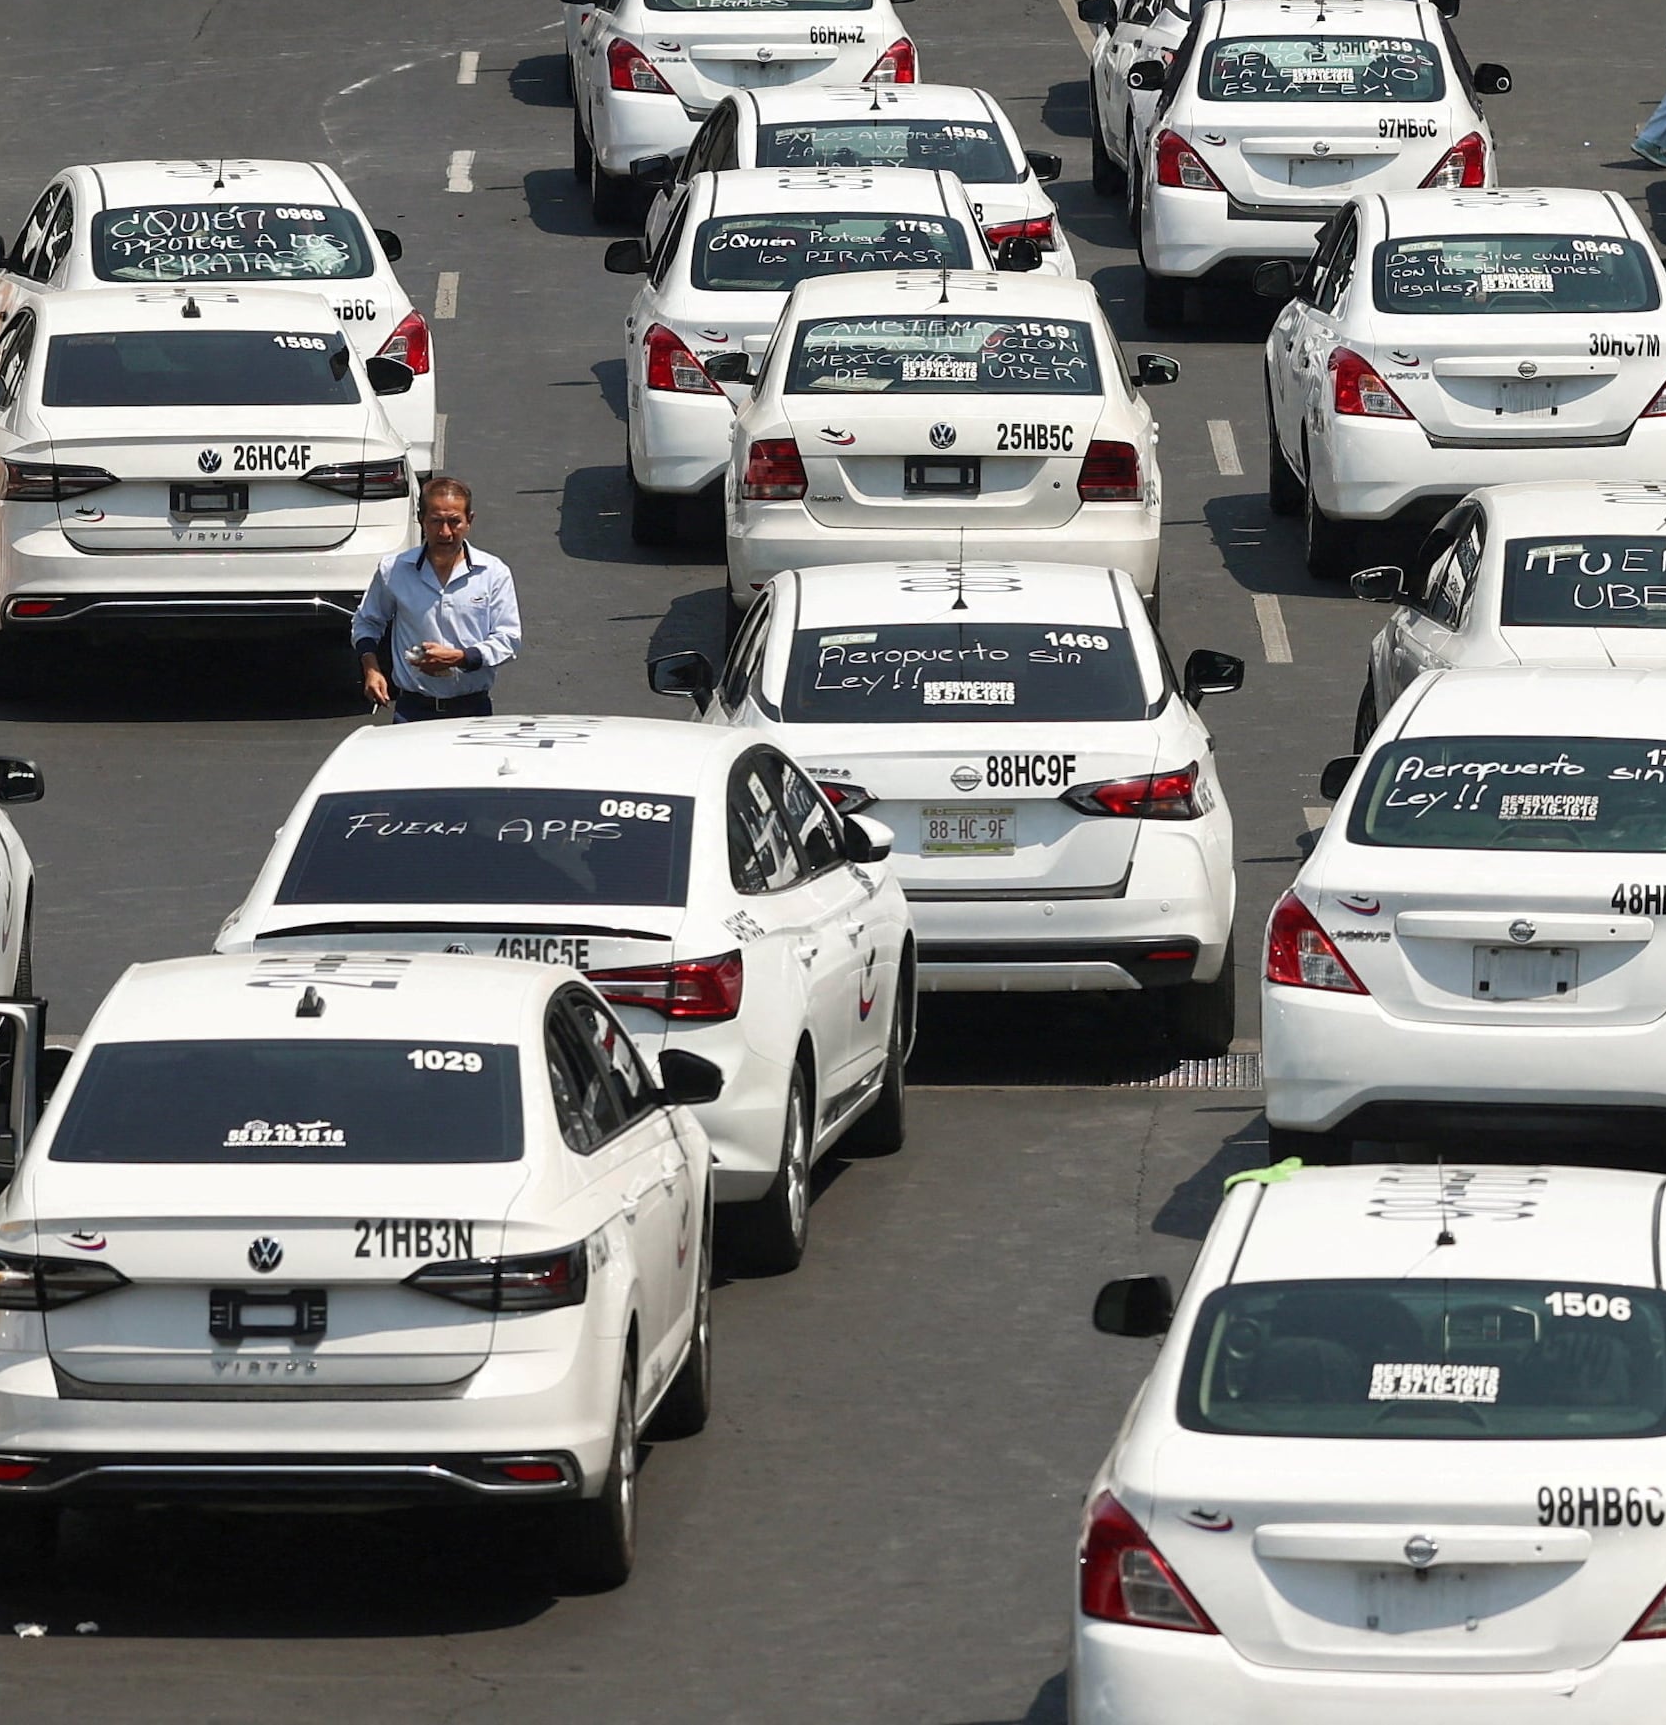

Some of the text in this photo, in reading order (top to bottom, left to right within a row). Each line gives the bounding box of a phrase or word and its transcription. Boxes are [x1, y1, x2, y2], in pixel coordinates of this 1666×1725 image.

[1367, 39, 1413, 53] 0139
[1222, 82, 1393, 97] ES LA LEY!
[941, 126, 991, 141] 1559
[276, 206, 330, 222] 0968
[895, 219, 945, 235] 1753
[111, 232, 351, 255] PROTEGE A LOS
[1571, 239, 1625, 256] 0846
[757, 250, 943, 264] los PIRATAS?
[1388, 252, 1421, 266] De
[1474, 250, 1522, 262] sirve
[1532, 250, 1605, 265] cumplir
[1392, 279, 1479, 298] legales?
[1015, 322, 1071, 339] 1519
[273, 334, 327, 352] 1586
[1588, 331, 1660, 358] 30HC7M
[902, 361, 979, 370] RESERVACIONES
[981, 352, 1036, 366] POR
[1050, 354, 1089, 370] LA
[834, 366, 1078, 383] DE UBER
[995, 423, 1074, 452] 25HB5C
[233, 444, 312, 472] 26HC4F
[1043, 630, 1110, 652] 1469
[819, 640, 1082, 671] Aeropuerto sin
[814, 667, 925, 693] Ley!!
[924, 681, 1015, 692] RESERVACIONES
[923, 690, 1015, 702] 55 5716-1616
[985, 754, 1076, 788] 88HC9F
[1394, 753, 1665, 784] Aeropuerto sin
[1385, 783, 1488, 819] Ley!!
[1501, 794, 1600, 806] RESERVACIONES
[598, 798, 672, 823] 0862
[1499, 804, 1599, 816] 55 5716-1616
[928, 818, 1006, 840] 88-HC-9F
[406, 1048, 484, 1074] 1029
[353, 1218, 475, 1262] 21HB3N
[1544, 1291, 1632, 1322] 1506
[1372, 1362, 1502, 1379] RESERVACIONES
[1370, 1376, 1500, 1395] 55 5716-1616
[1538, 1486, 1666, 1527] 98HB6C
